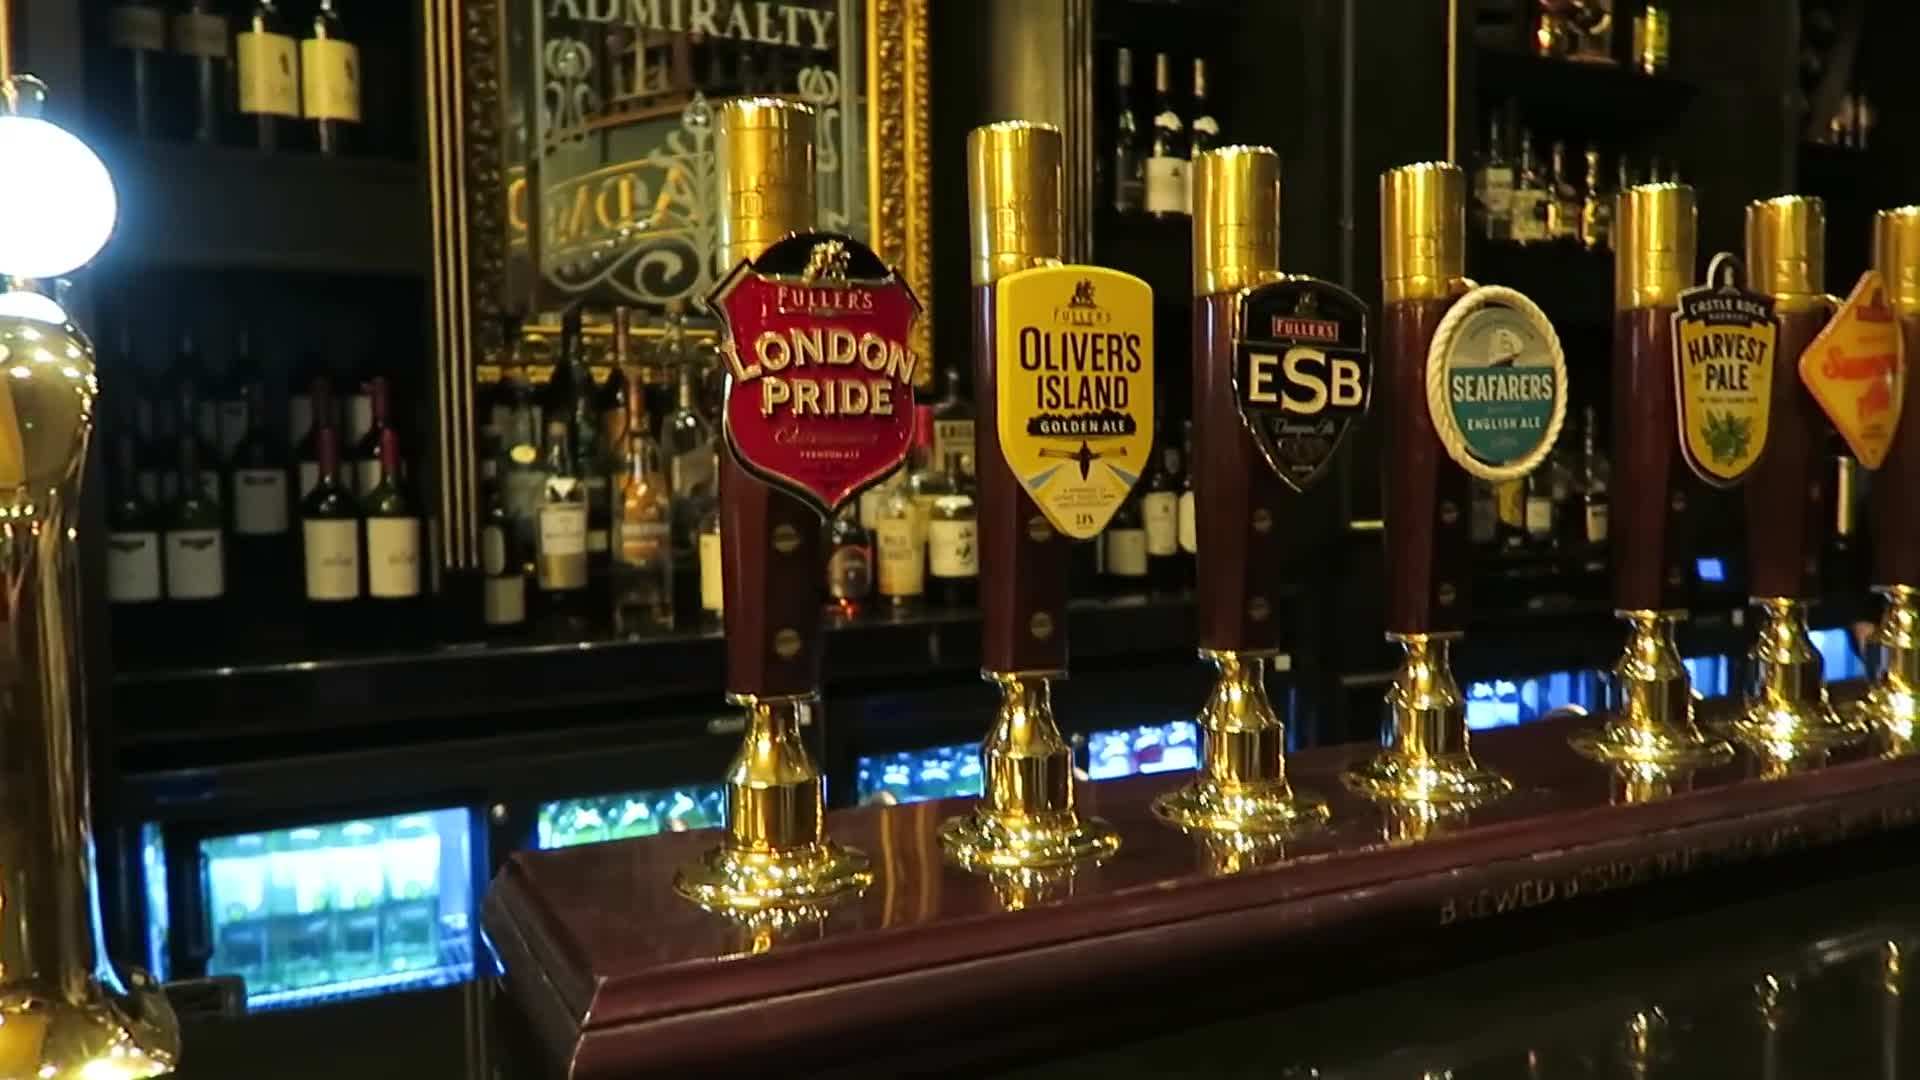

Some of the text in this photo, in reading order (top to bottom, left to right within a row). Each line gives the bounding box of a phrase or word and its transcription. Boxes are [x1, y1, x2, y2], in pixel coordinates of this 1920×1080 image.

[550, 0, 835, 50] ADMIRALTY
[777, 286, 874, 310] FULLER'S
[1690, 299, 1766, 318] CASTLE ROCK
[726, 327, 917, 384] LONDON
[1019, 326, 1142, 373] OLIVER'S
[1688, 333, 1767, 367] HARVEST
[1036, 375, 1130, 410] ISLAND
[1250, 346, 1363, 415] ESB
[1452, 374, 1553, 402] SEAFARERS
[1706, 364, 1749, 390] PALE
[760, 376, 895, 417] PRIDE
[1040, 419, 1125, 434] GOLDEN ALE
[1467, 416, 1541, 431] ENGLISH ALE
